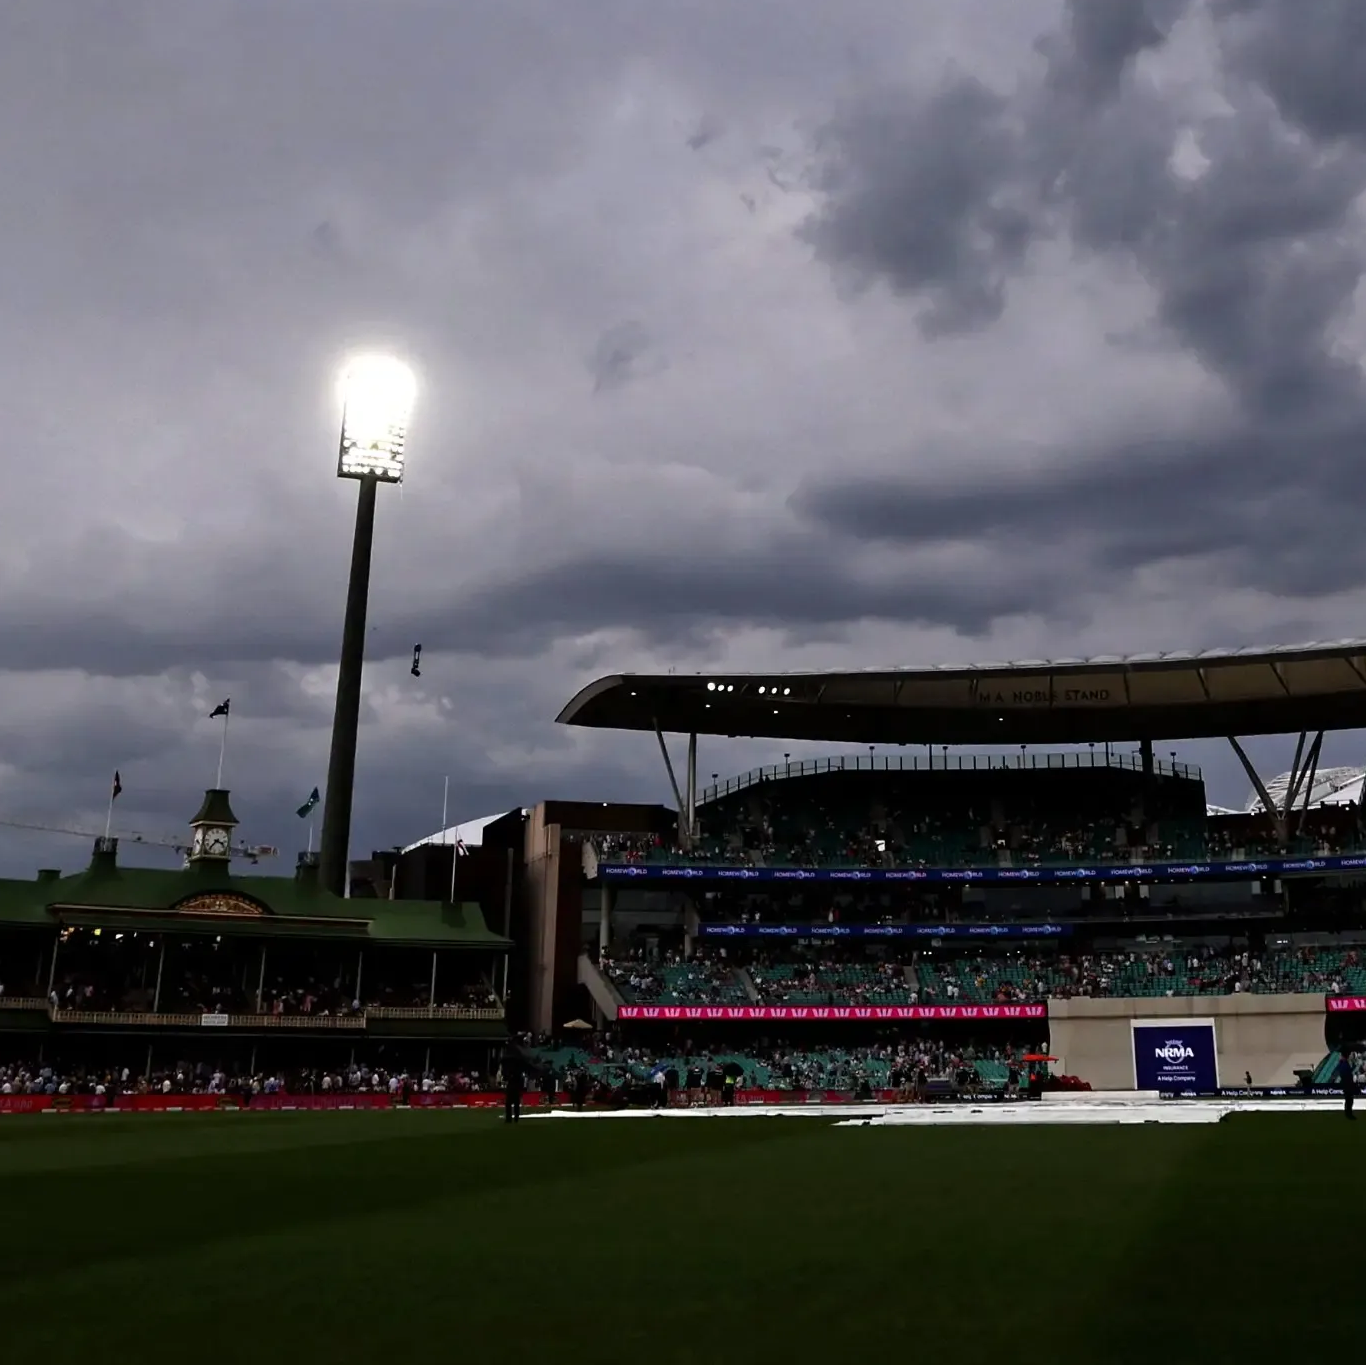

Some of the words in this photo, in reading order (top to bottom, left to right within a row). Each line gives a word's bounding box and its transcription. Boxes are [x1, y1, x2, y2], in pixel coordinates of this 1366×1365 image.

[979, 692, 990, 702] M
[995, 692, 1004, 702] A
[1065, 689, 1110, 701] STAND
[1155, 1046, 1195, 1058] NRMA
